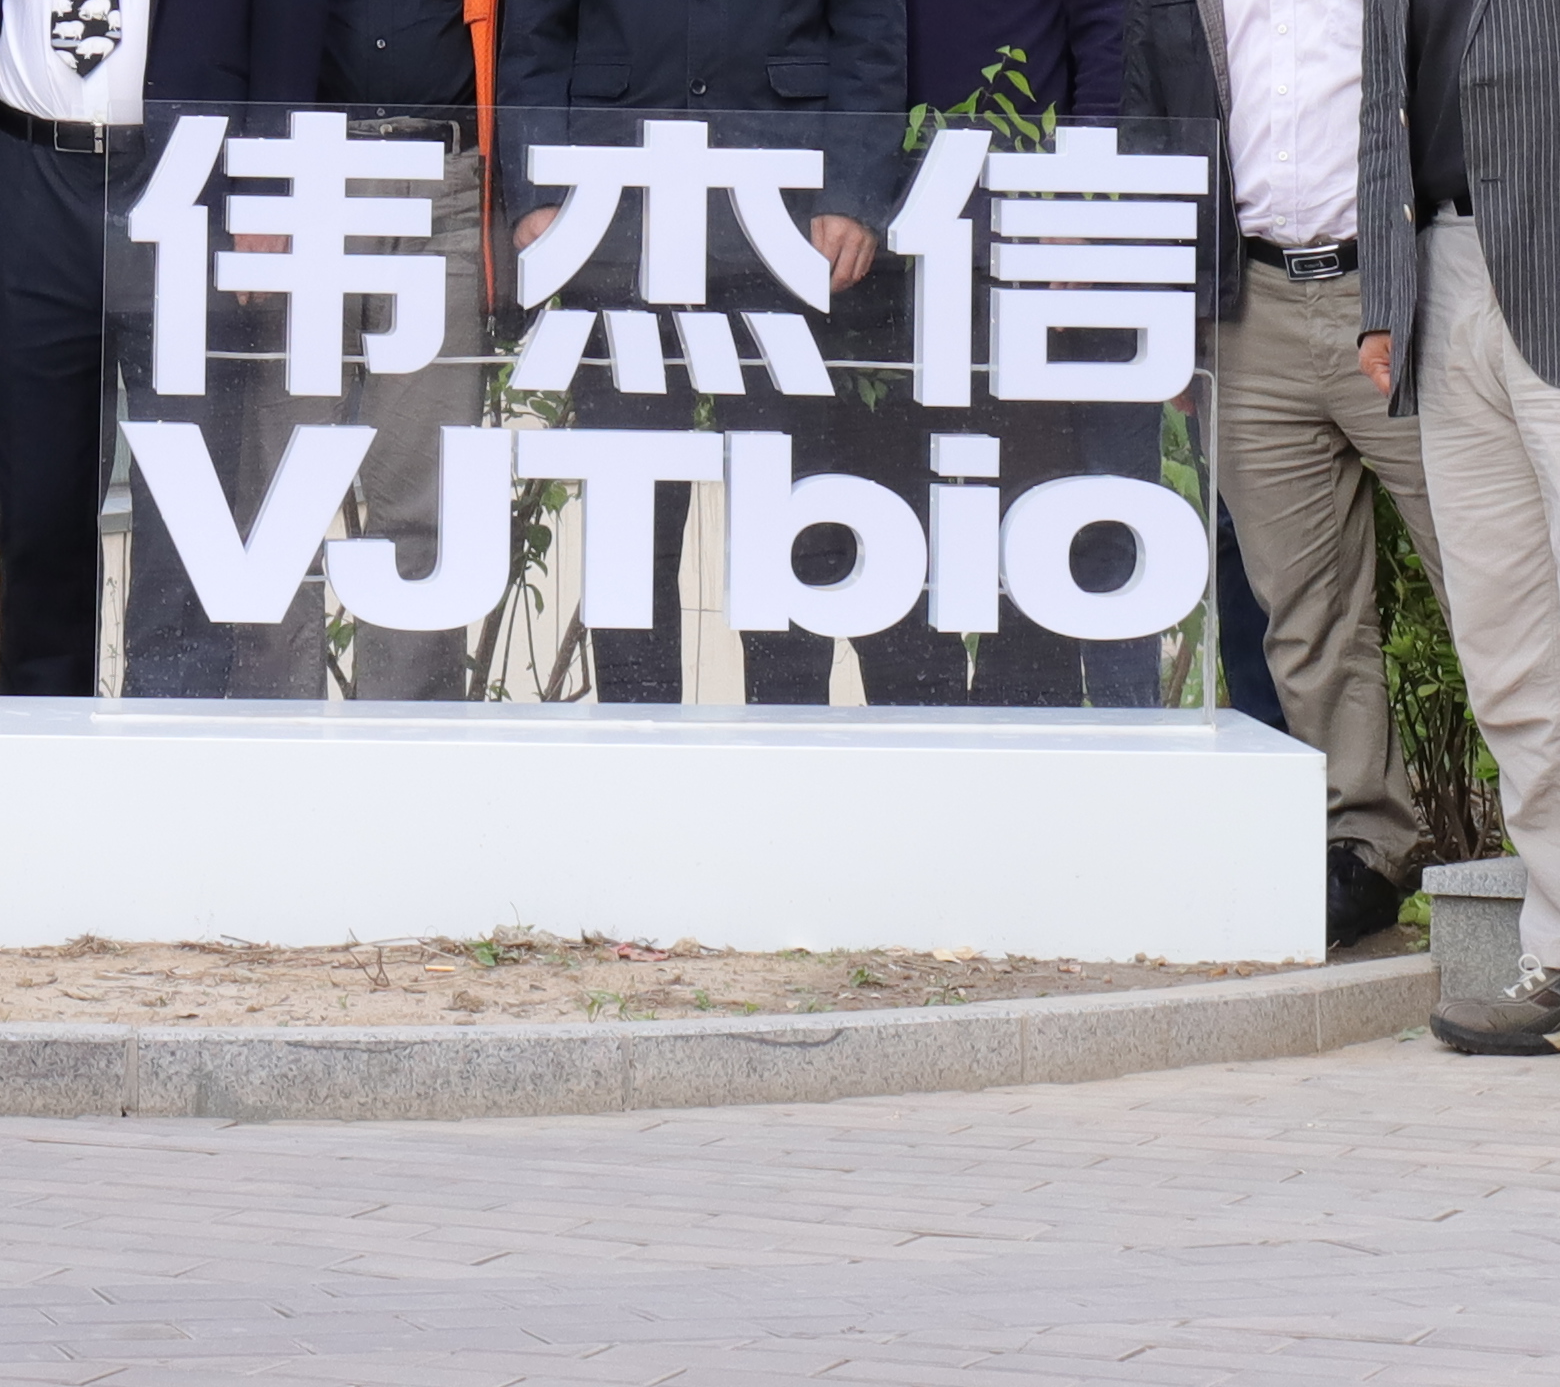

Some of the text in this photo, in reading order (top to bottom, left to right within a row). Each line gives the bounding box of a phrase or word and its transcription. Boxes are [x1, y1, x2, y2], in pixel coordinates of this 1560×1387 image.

[127, 111, 1209, 407] 伟杰信
[118, 420, 1210, 640] VJTbio
